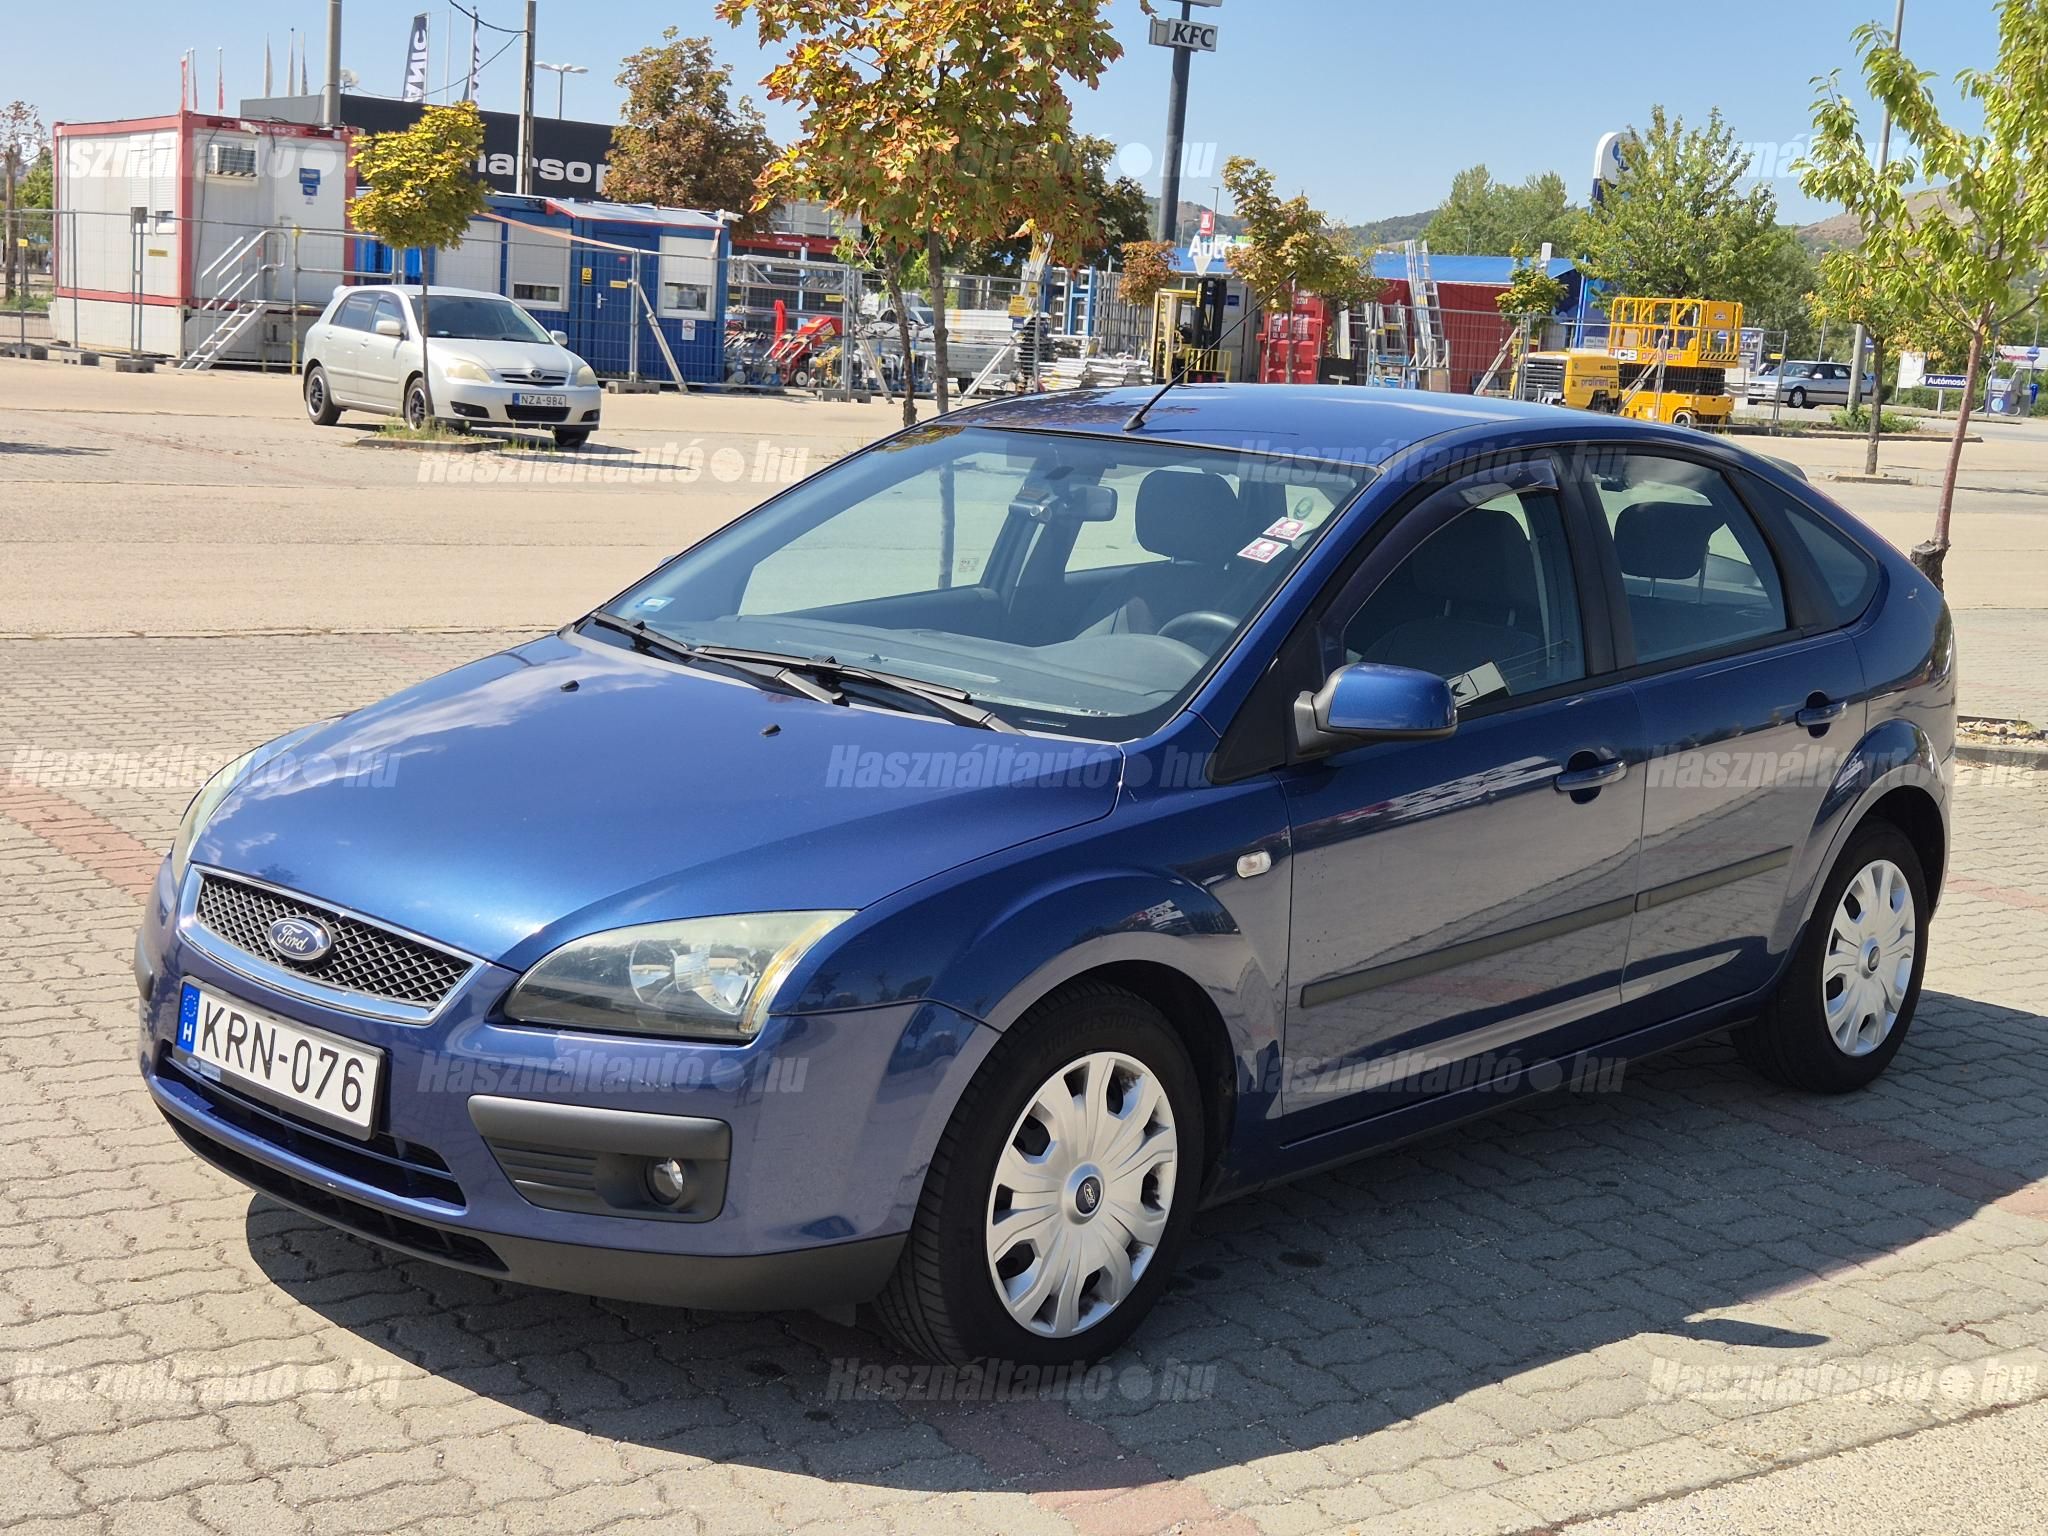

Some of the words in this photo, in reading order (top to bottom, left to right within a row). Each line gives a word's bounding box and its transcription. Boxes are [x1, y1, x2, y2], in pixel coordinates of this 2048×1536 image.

[1172, 23, 1214, 47] KFC
[521, 395, 563, 406] NZA-984
[277, 924, 306, 951] Ford
[182, 1021, 193, 1043] H
[201, 1001, 364, 1113] KRN-076
